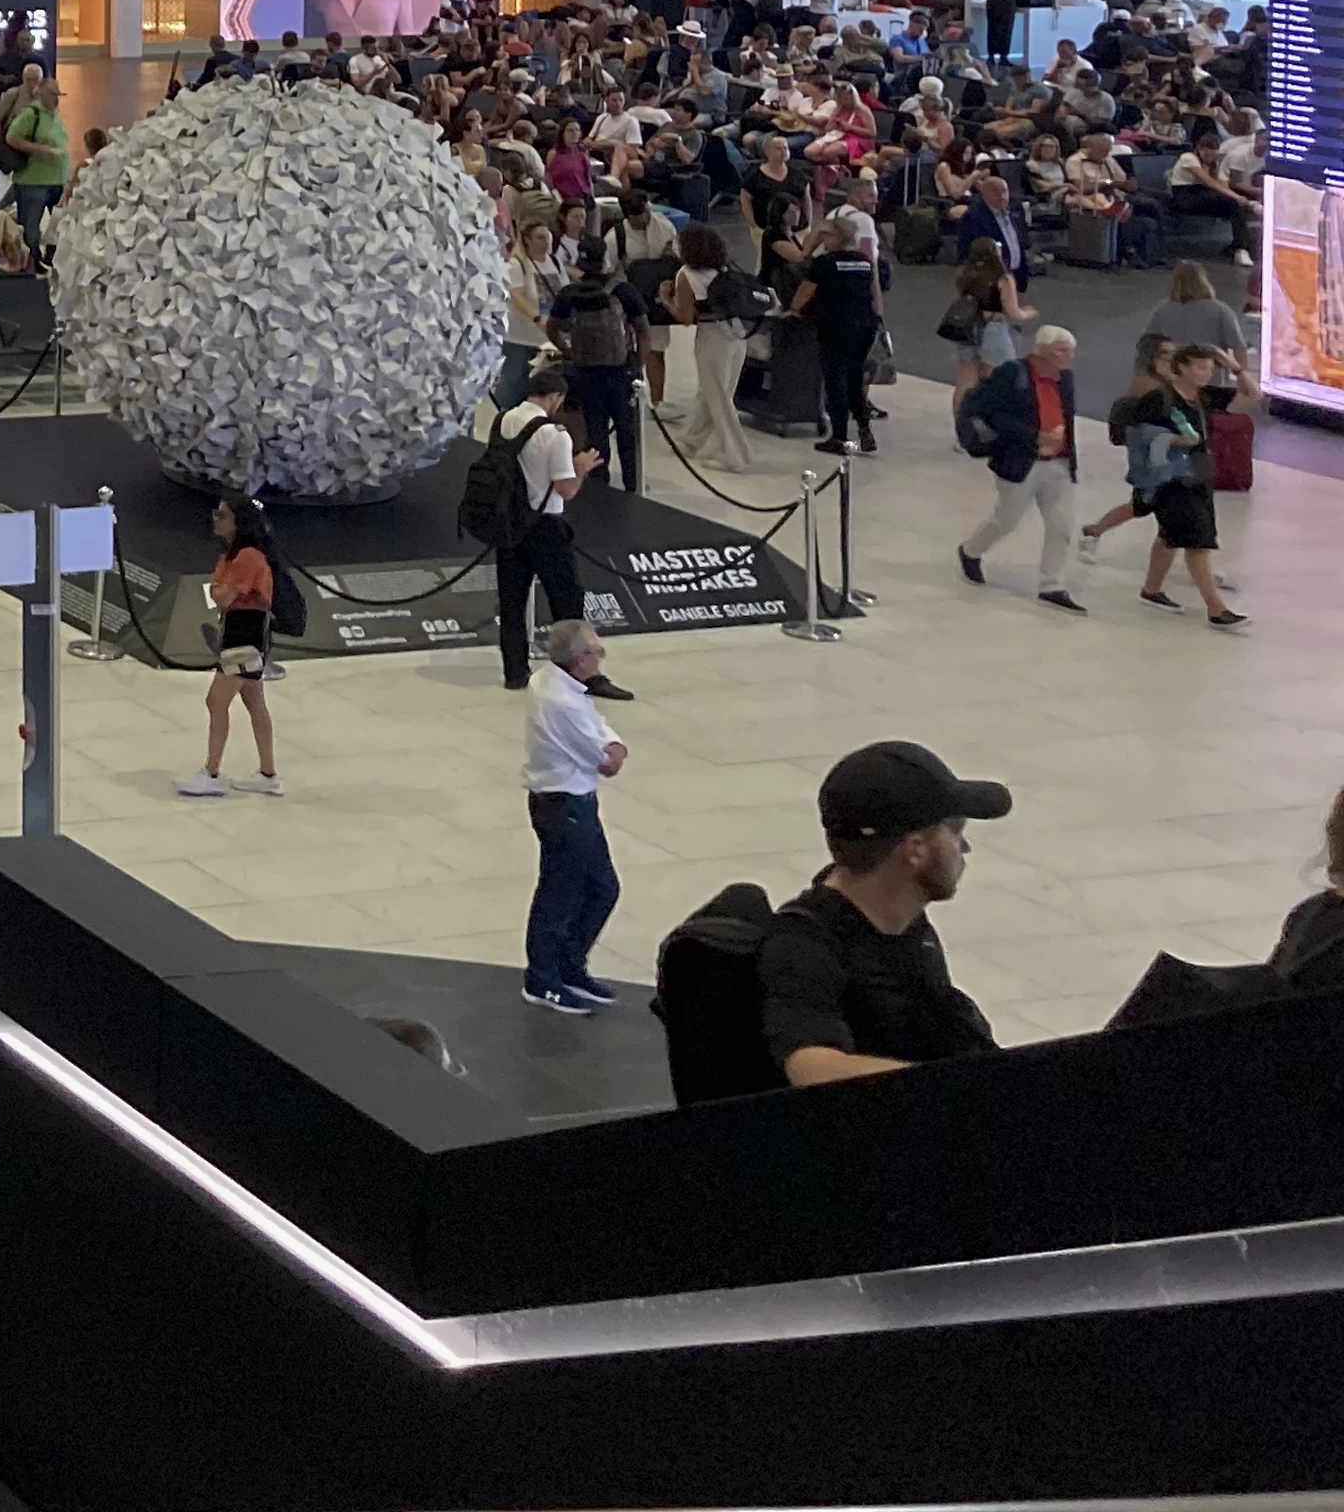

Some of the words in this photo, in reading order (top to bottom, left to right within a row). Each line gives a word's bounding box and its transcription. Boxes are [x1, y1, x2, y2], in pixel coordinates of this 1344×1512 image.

[628, 547, 725, 573] MASTER
[723, 545, 755, 565] OF
[640, 568, 758, 595] MISTAKES
[659, 604, 724, 623] DANIELE
[724, 600, 787, 618] SIGALOT
